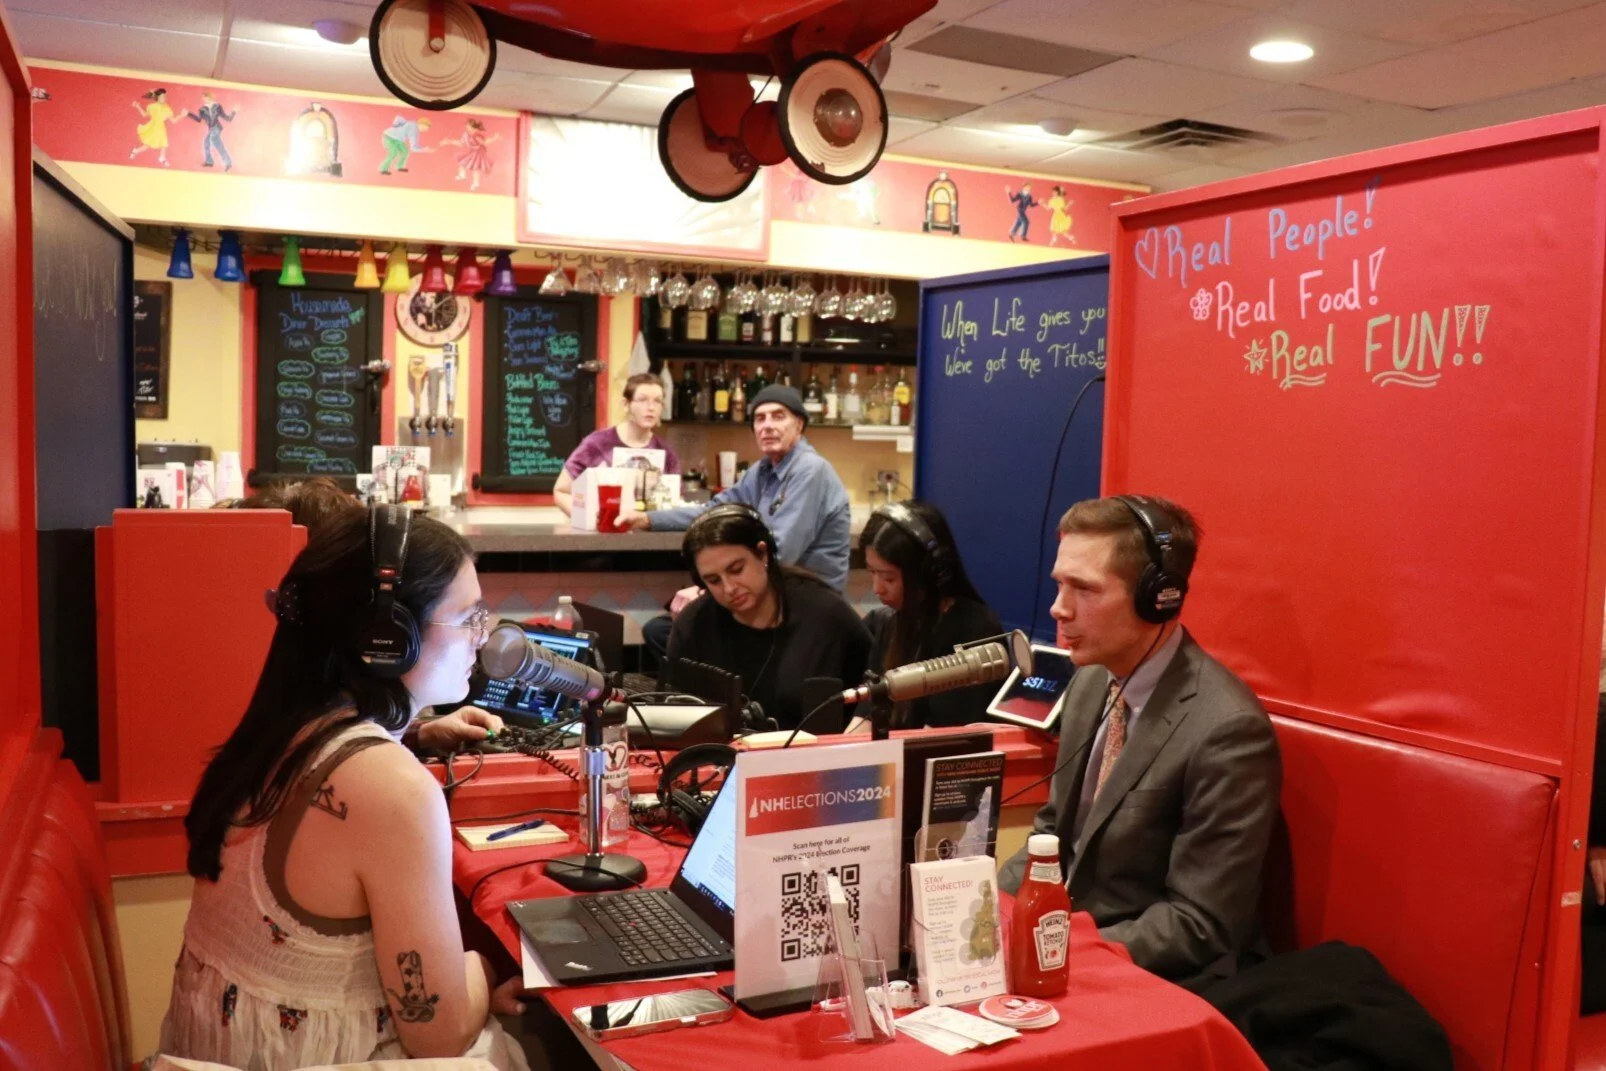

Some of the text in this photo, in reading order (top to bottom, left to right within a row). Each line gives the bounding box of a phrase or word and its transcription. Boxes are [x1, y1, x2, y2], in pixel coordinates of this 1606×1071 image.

[1164, 175, 1382, 288] Real People!
[1215, 246, 1386, 338] Real Food!
[941, 297, 1106, 347] When Life gives you
[1270, 304, 1491, 383] Real FUN!!
[984, 348, 1006, 383] got
[1017, 348, 1041, 379] the
[793, 842, 808, 850] Scan
[809, 840, 824, 849] here
[825, 838, 833, 846] for
[841, 844, 871, 854] Coverage
[924, 875, 973, 893] STAY CONNECTED!
[1046, 918, 1063, 927] HEINZ
